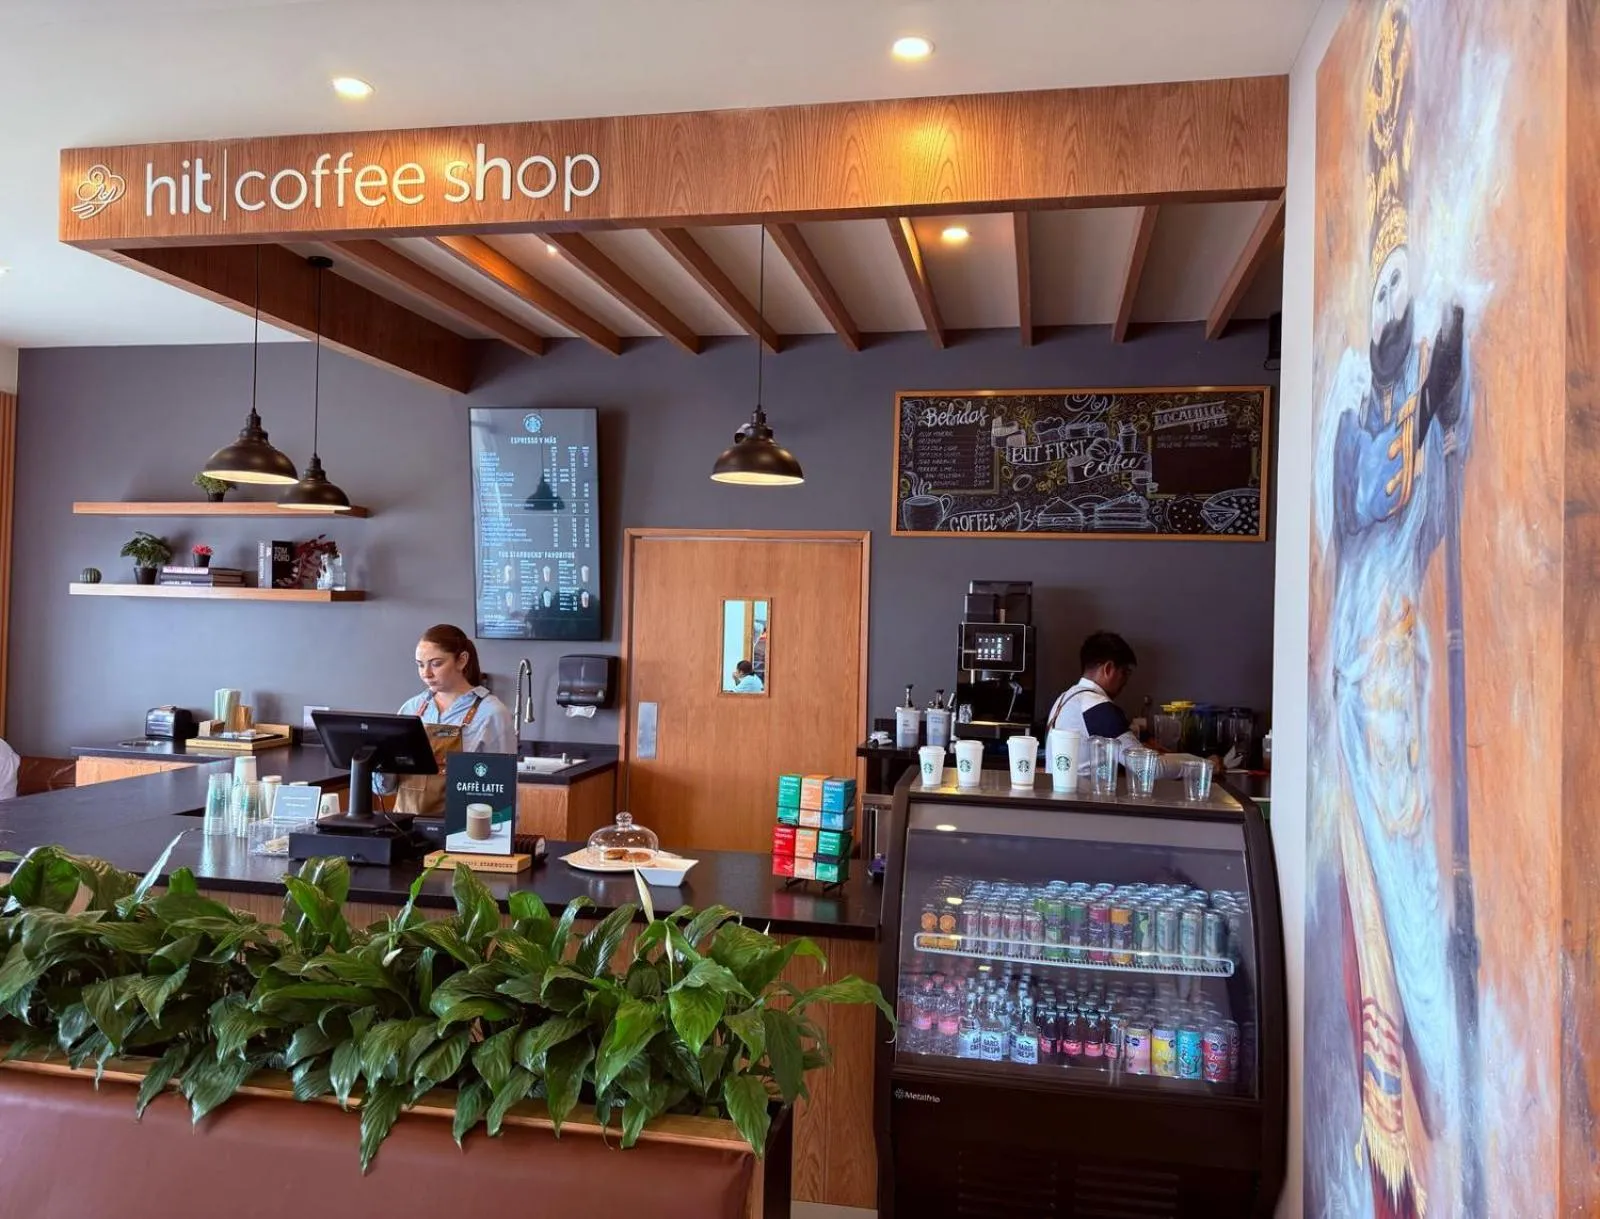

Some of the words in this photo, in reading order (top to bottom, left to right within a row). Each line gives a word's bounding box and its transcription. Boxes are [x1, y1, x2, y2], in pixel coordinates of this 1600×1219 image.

[146, 158, 212, 217] hit
[234, 151, 426, 212] coffee
[443, 143, 601, 212] shop
[918, 401, 990, 428] Bebidas
[510, 436, 538, 444] ESPRESSO
[1012, 446, 1040, 462] BUT
[1045, 439, 1087, 460] FIRST
[950, 513, 997, 532] COFFEE
[456, 781, 480, 792] CAFFÈ
[481, 783, 505, 793] LATTE
[904, 1091, 941, 1103] Metalfrio
